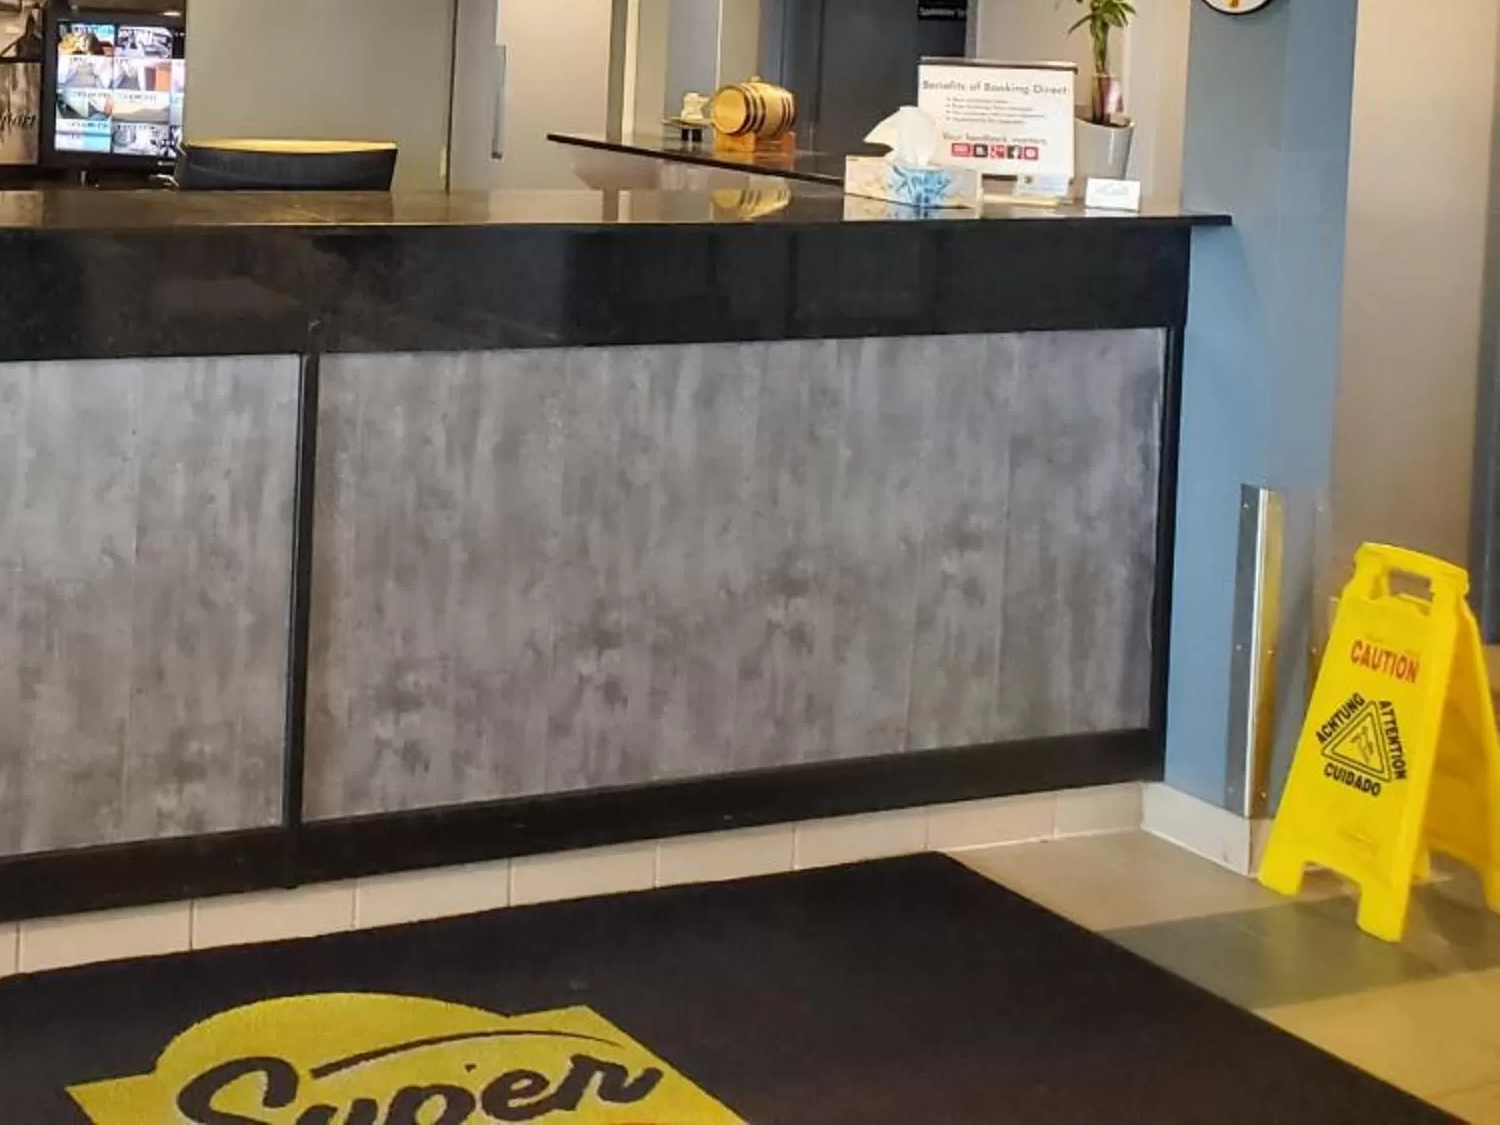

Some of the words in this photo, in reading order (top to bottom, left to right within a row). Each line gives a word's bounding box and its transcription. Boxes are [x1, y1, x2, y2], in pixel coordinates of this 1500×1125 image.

[922, 79, 966, 92] Benefits
[970, 81, 982, 92] of
[983, 81, 1030, 96] Booking
[1032, 83, 1068, 96] Direct
[1350, 638, 1421, 683] CAUTION
[1315, 692, 1366, 745] ACHTUNG
[1378, 700, 1409, 780] ATTENTION
[1323, 762, 1382, 798] CUIDADO
[176, 1053, 664, 1125] Super
